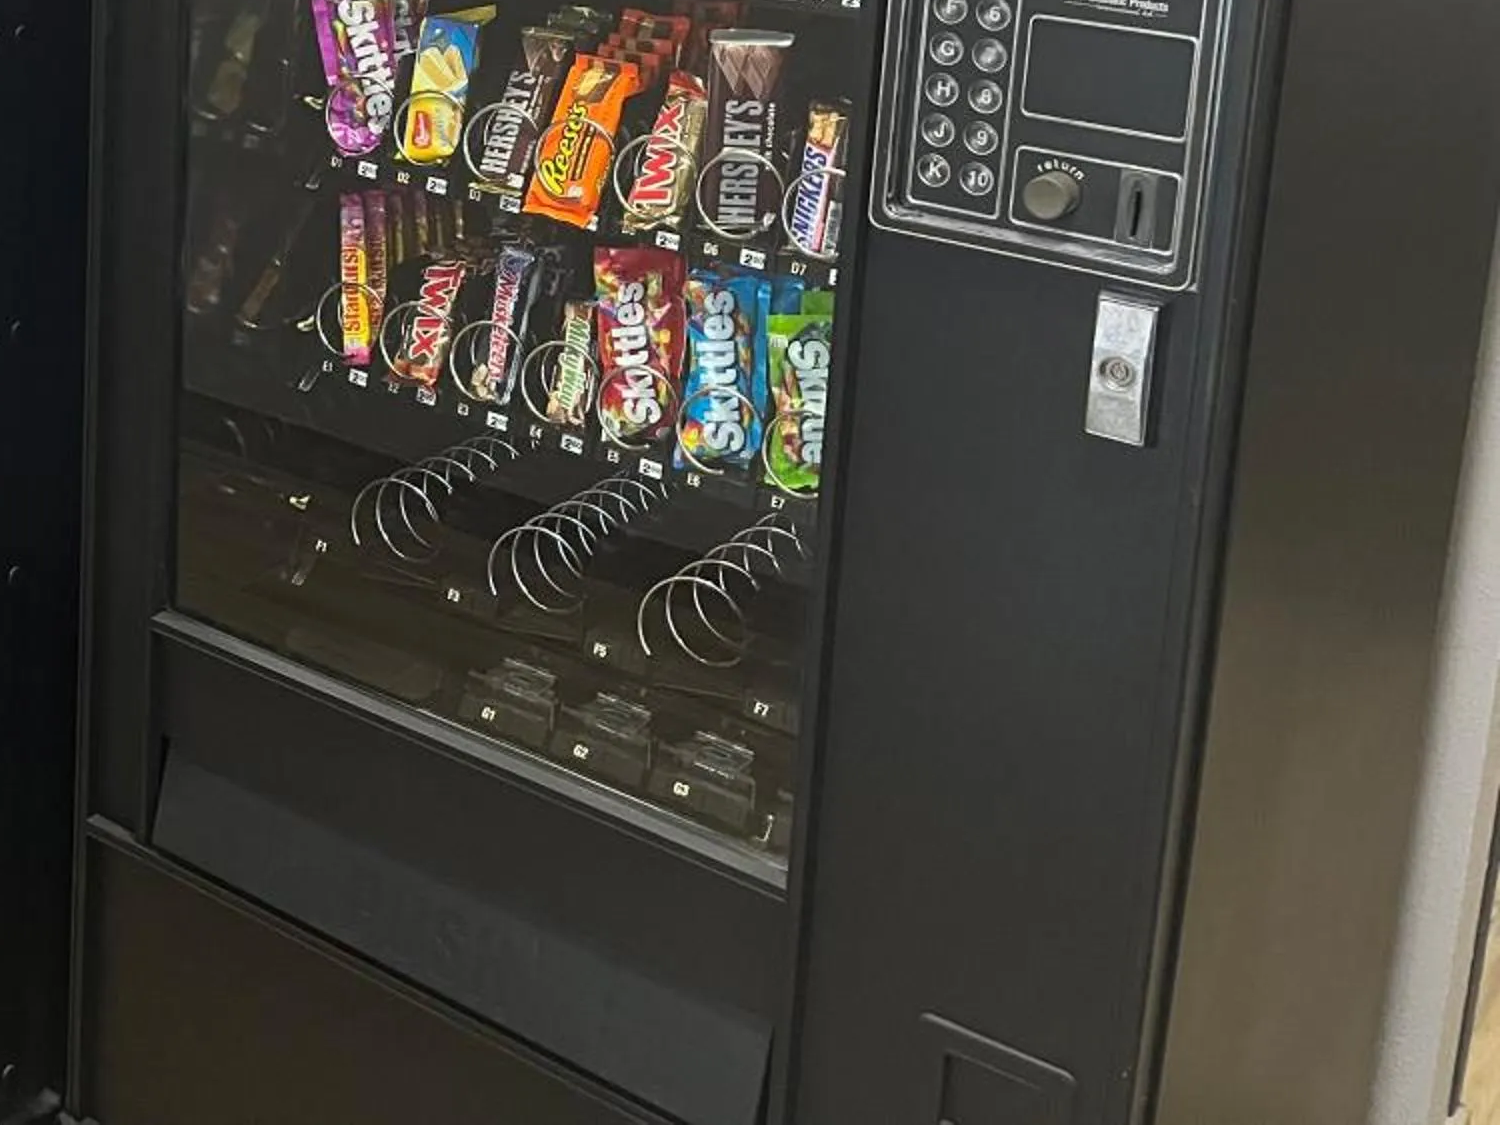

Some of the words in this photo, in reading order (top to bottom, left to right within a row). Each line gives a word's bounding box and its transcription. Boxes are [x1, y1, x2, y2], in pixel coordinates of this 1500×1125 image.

[989, 6, 1000, 22] 6
[941, 40, 954, 56] G
[936, 80, 950, 97] H
[981, 88, 992, 104] 8
[934, 121, 945, 137] J
[976, 130, 987, 146] 9
[929, 162, 942, 179] K
[1037, 158, 1085, 180] return
[968, 171, 989, 187] 10
[703, 243, 719, 255] D6
[791, 262, 806, 274] D7
[409, 263, 464, 359] TWIX
[315, 539, 327, 552] F1
[593, 642, 607, 658] F5
[481, 706, 496, 722] G1
[753, 702, 770, 717] F7
[573, 743, 589, 760] G2
[673, 781, 690, 797] G3
